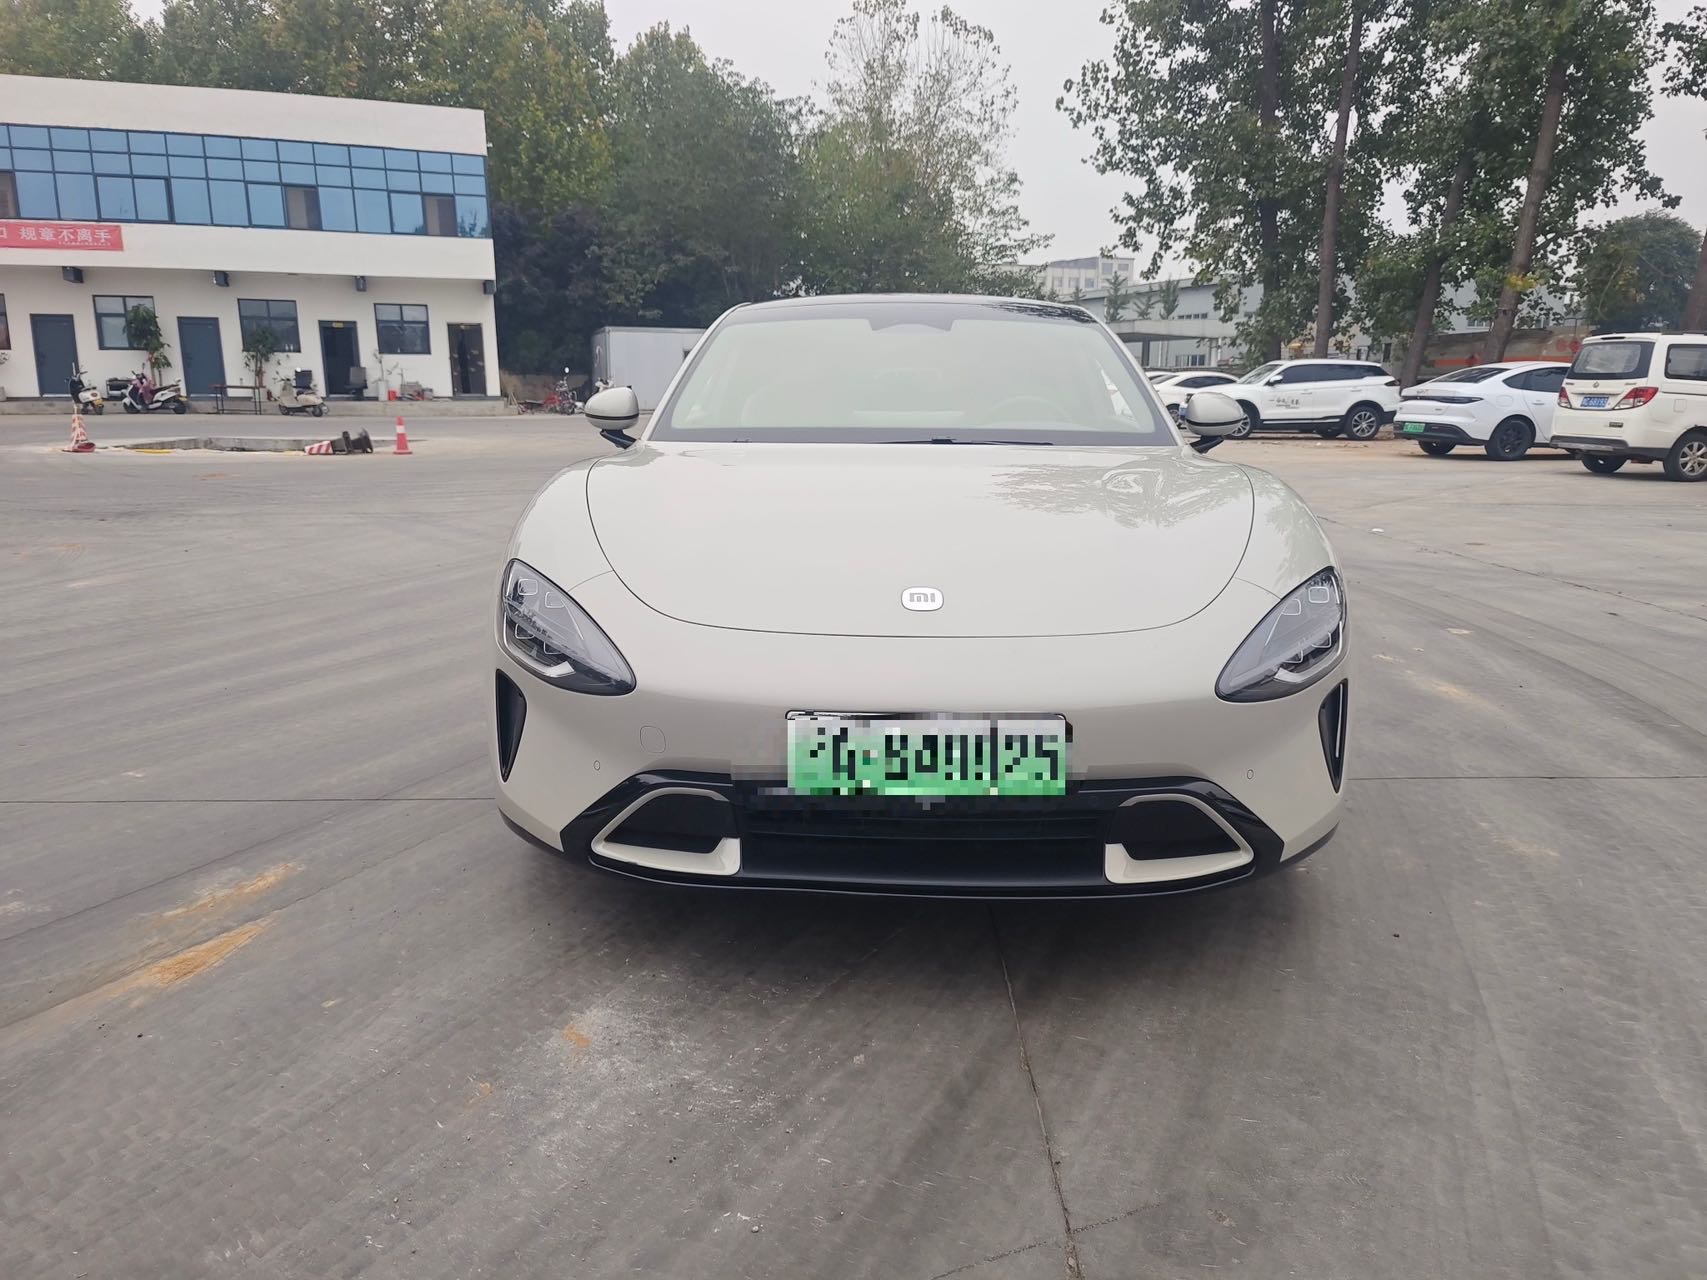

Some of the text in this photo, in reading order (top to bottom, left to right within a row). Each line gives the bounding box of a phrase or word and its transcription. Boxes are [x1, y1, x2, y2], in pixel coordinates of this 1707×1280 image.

[20, 226, 111, 242] 规章不离手
